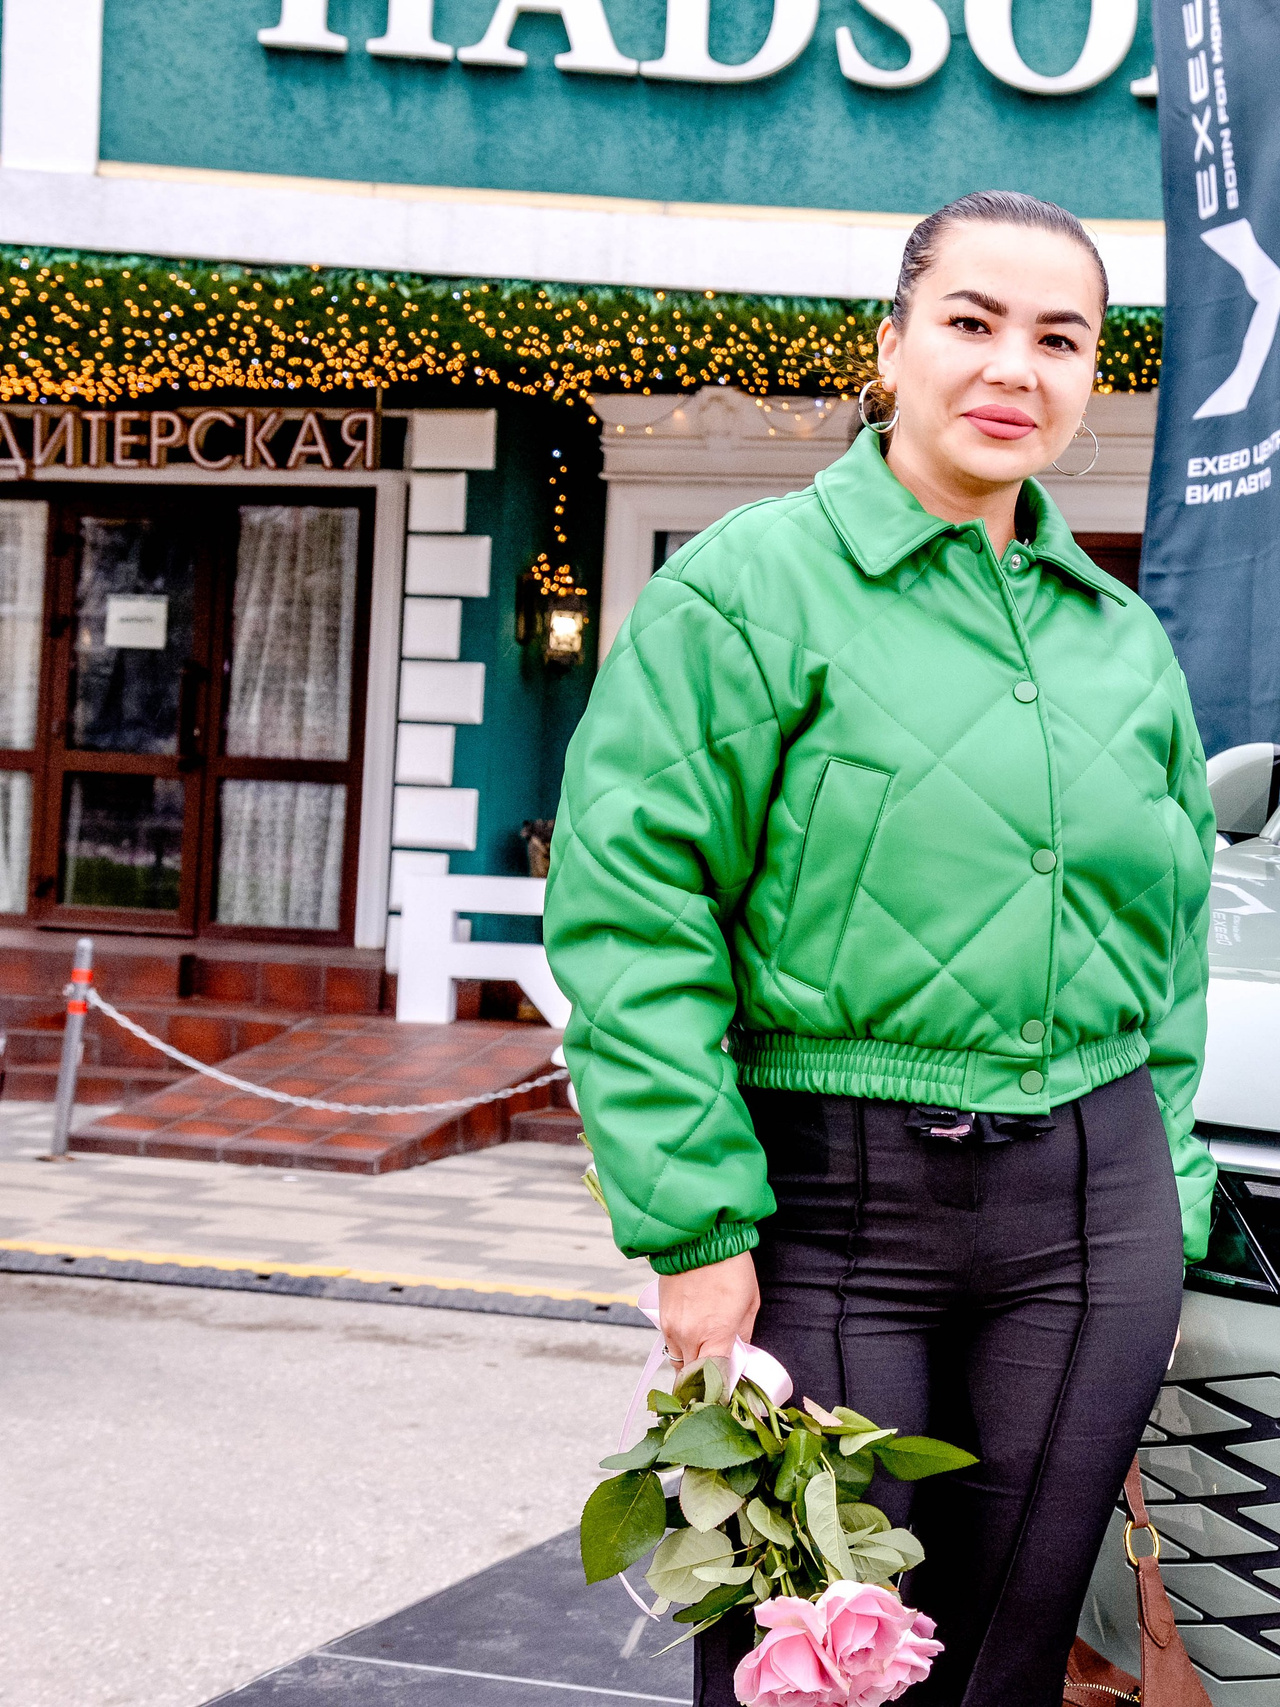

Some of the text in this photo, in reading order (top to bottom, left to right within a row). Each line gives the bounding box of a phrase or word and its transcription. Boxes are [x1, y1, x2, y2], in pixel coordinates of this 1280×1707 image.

[1213, 67, 1230, 125] FOR
[1220, 127, 1240, 210] BORN
[1186, 447, 1251, 479] EXEED
[1185, 479, 1233, 506] ВИП
